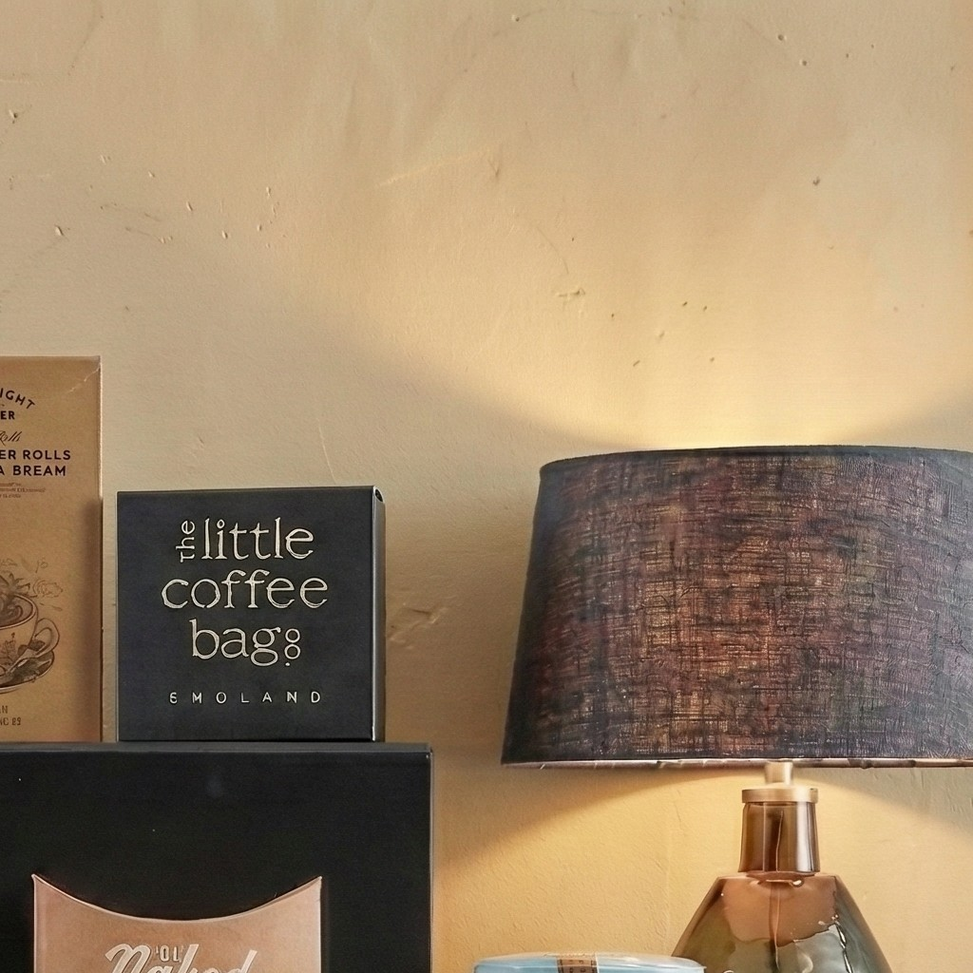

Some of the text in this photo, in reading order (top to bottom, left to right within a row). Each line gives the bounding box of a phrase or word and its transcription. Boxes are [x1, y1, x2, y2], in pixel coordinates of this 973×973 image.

[22, 449, 71, 461] ROLLS
[12, 464, 67, 477] BREAM
[175, 516, 315, 563] the little
[161, 568, 329, 609] coffee
